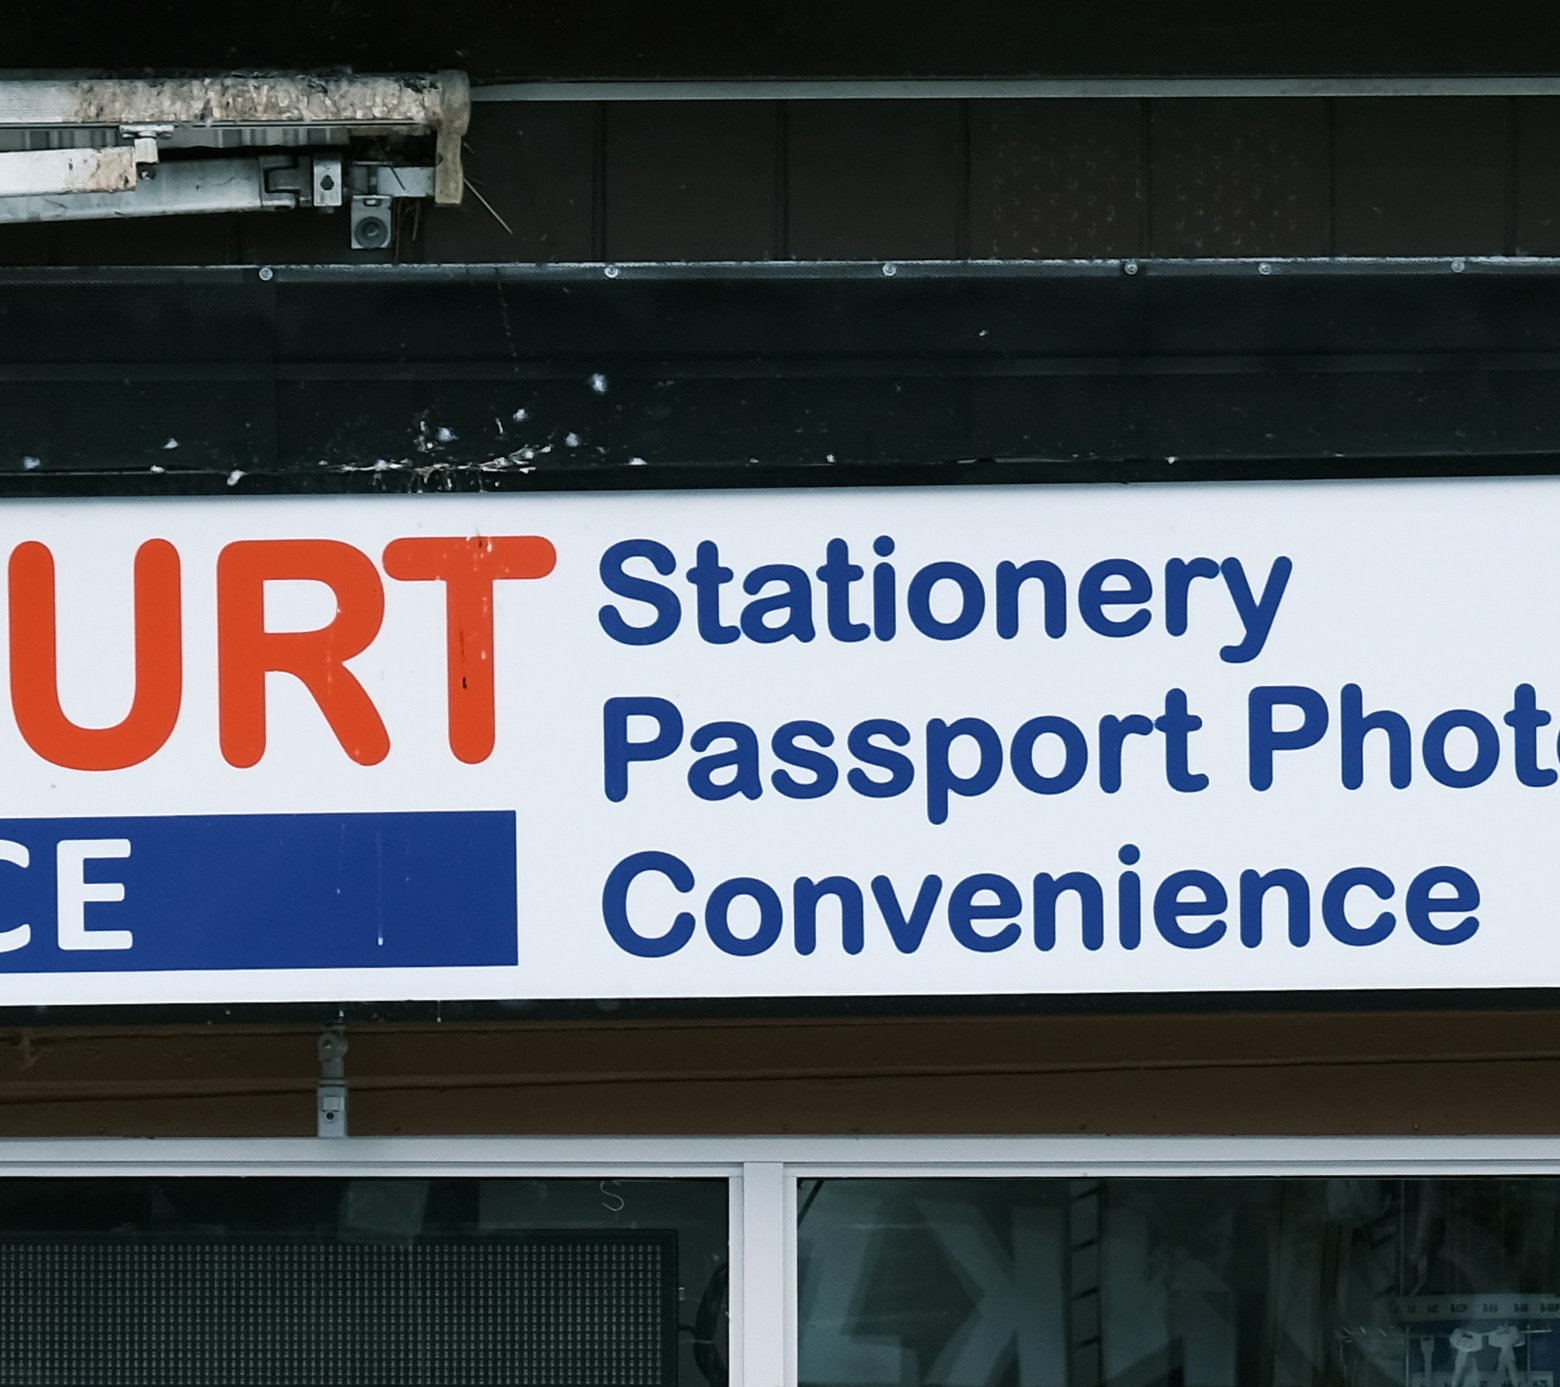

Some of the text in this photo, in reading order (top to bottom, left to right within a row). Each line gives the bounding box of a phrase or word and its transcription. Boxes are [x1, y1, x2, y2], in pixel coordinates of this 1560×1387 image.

[599, 536, 1292, 664] Stationery
[603, 689, 1209, 825] Passport
[602, 844, 1481, 958] Convenience
